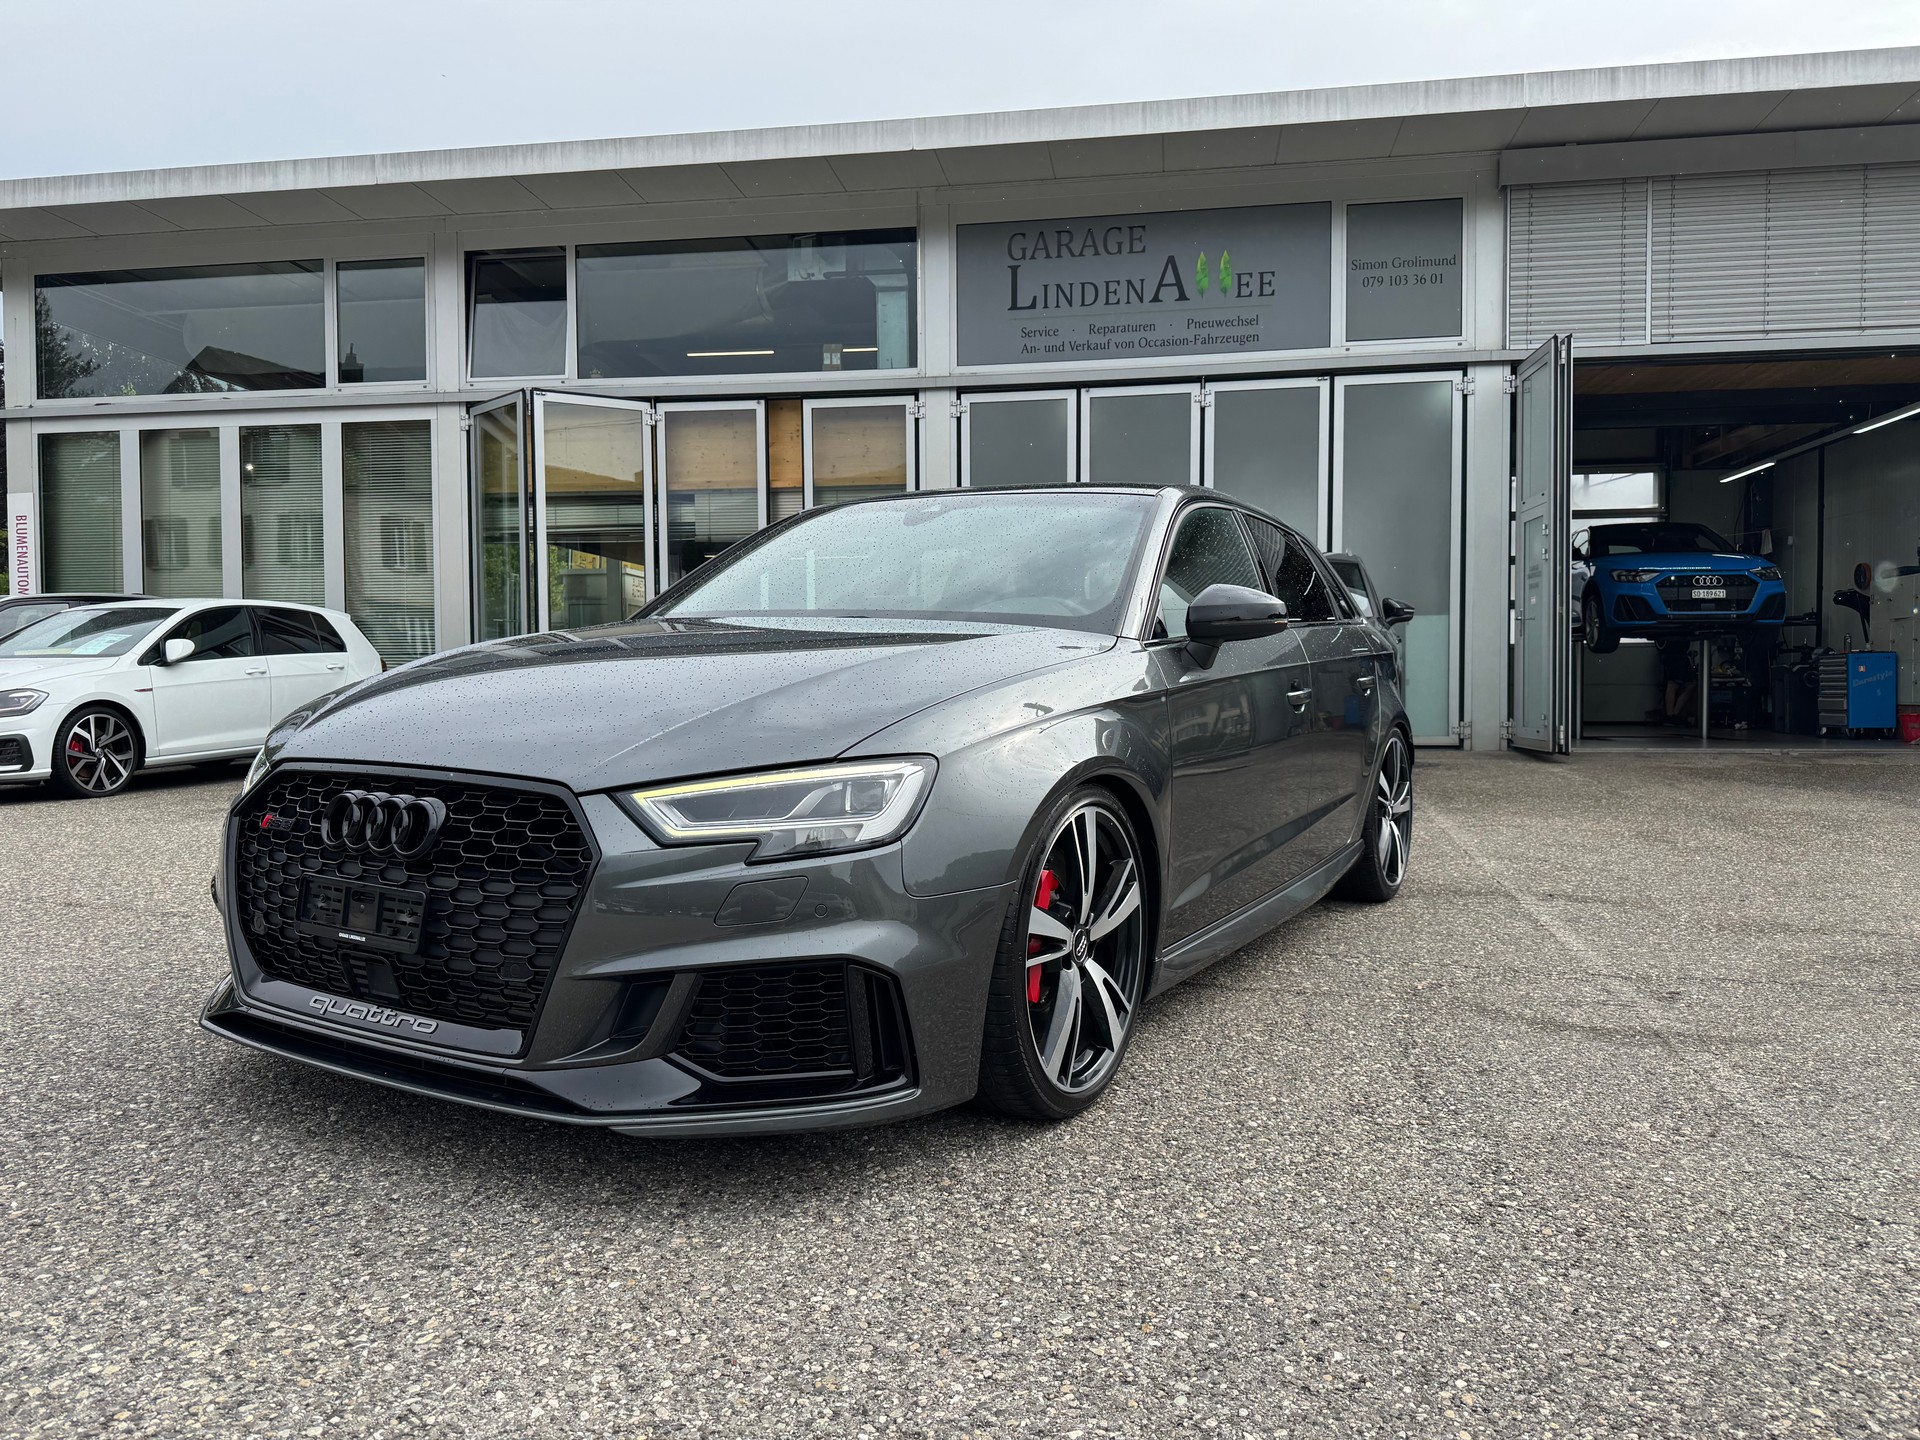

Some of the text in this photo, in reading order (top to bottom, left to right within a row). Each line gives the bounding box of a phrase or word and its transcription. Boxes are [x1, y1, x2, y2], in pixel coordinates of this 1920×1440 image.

[1007, 225, 1147, 261] GARAGE
[1351, 254, 1457, 271] Simon Grolimund
[1362, 273, 1444, 288] 079 103 36 01
[1020, 314, 1260, 338] Service Reparaturen Pneuwechsel
[1020, 333, 1260, 354] An- und Verkauf von Occasion-Fahrzeugen
[309, 995, 438, 1034] quattro
